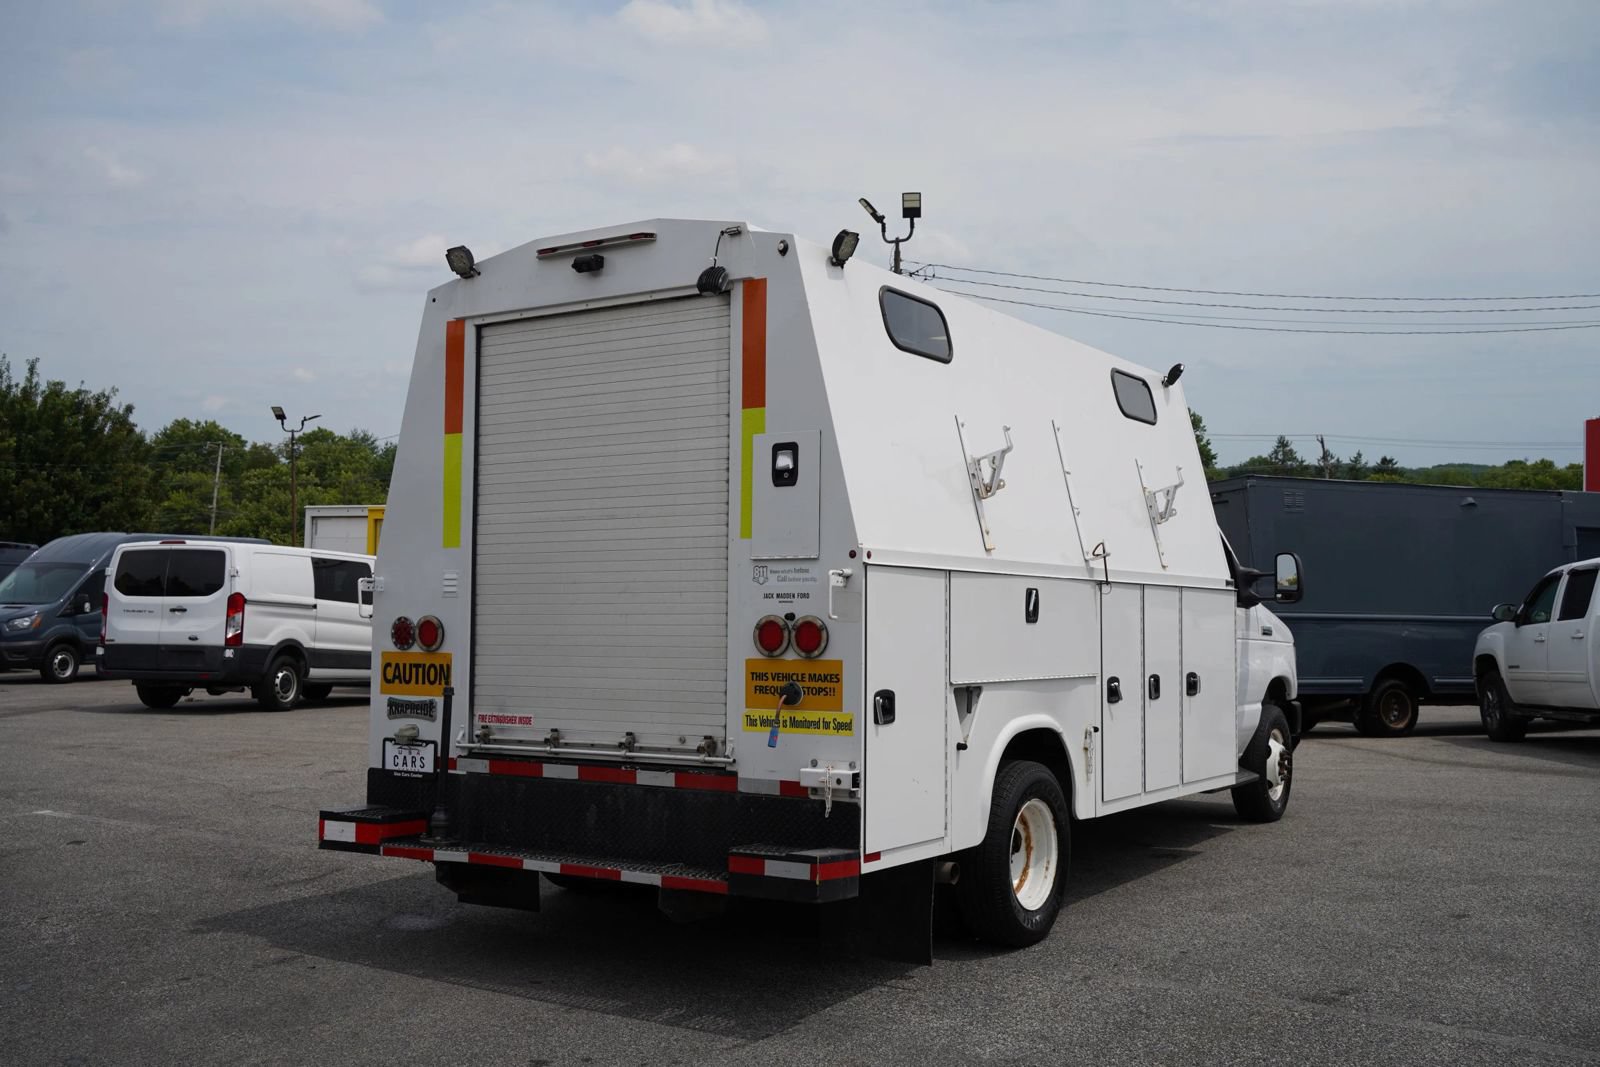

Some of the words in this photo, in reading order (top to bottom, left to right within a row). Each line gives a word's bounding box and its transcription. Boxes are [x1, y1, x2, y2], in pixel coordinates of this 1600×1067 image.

[753, 565, 768, 578] 811
[383, 662, 450, 685] CAUTION
[750, 671, 769, 682] THIS
[771, 672, 806, 683] VEHICLE
[808, 673, 840, 683] MAKES
[802, 686, 836, 697] STOPS!!
[388, 701, 435, 718] KNAPHEIDE
[478, 714, 487, 723] FIRE
[488, 714, 517, 725] EXTINGUISHER
[518, 716, 532, 726] INSIDE
[745, 715, 757, 727] This
[758, 715, 780, 728] Vehice
[782, 716, 788, 729] is
[789, 716, 820, 730] Monitored
[822, 717, 831, 730] for
[832, 717, 853, 733] Speed
[393, 755, 425, 769] CARS
